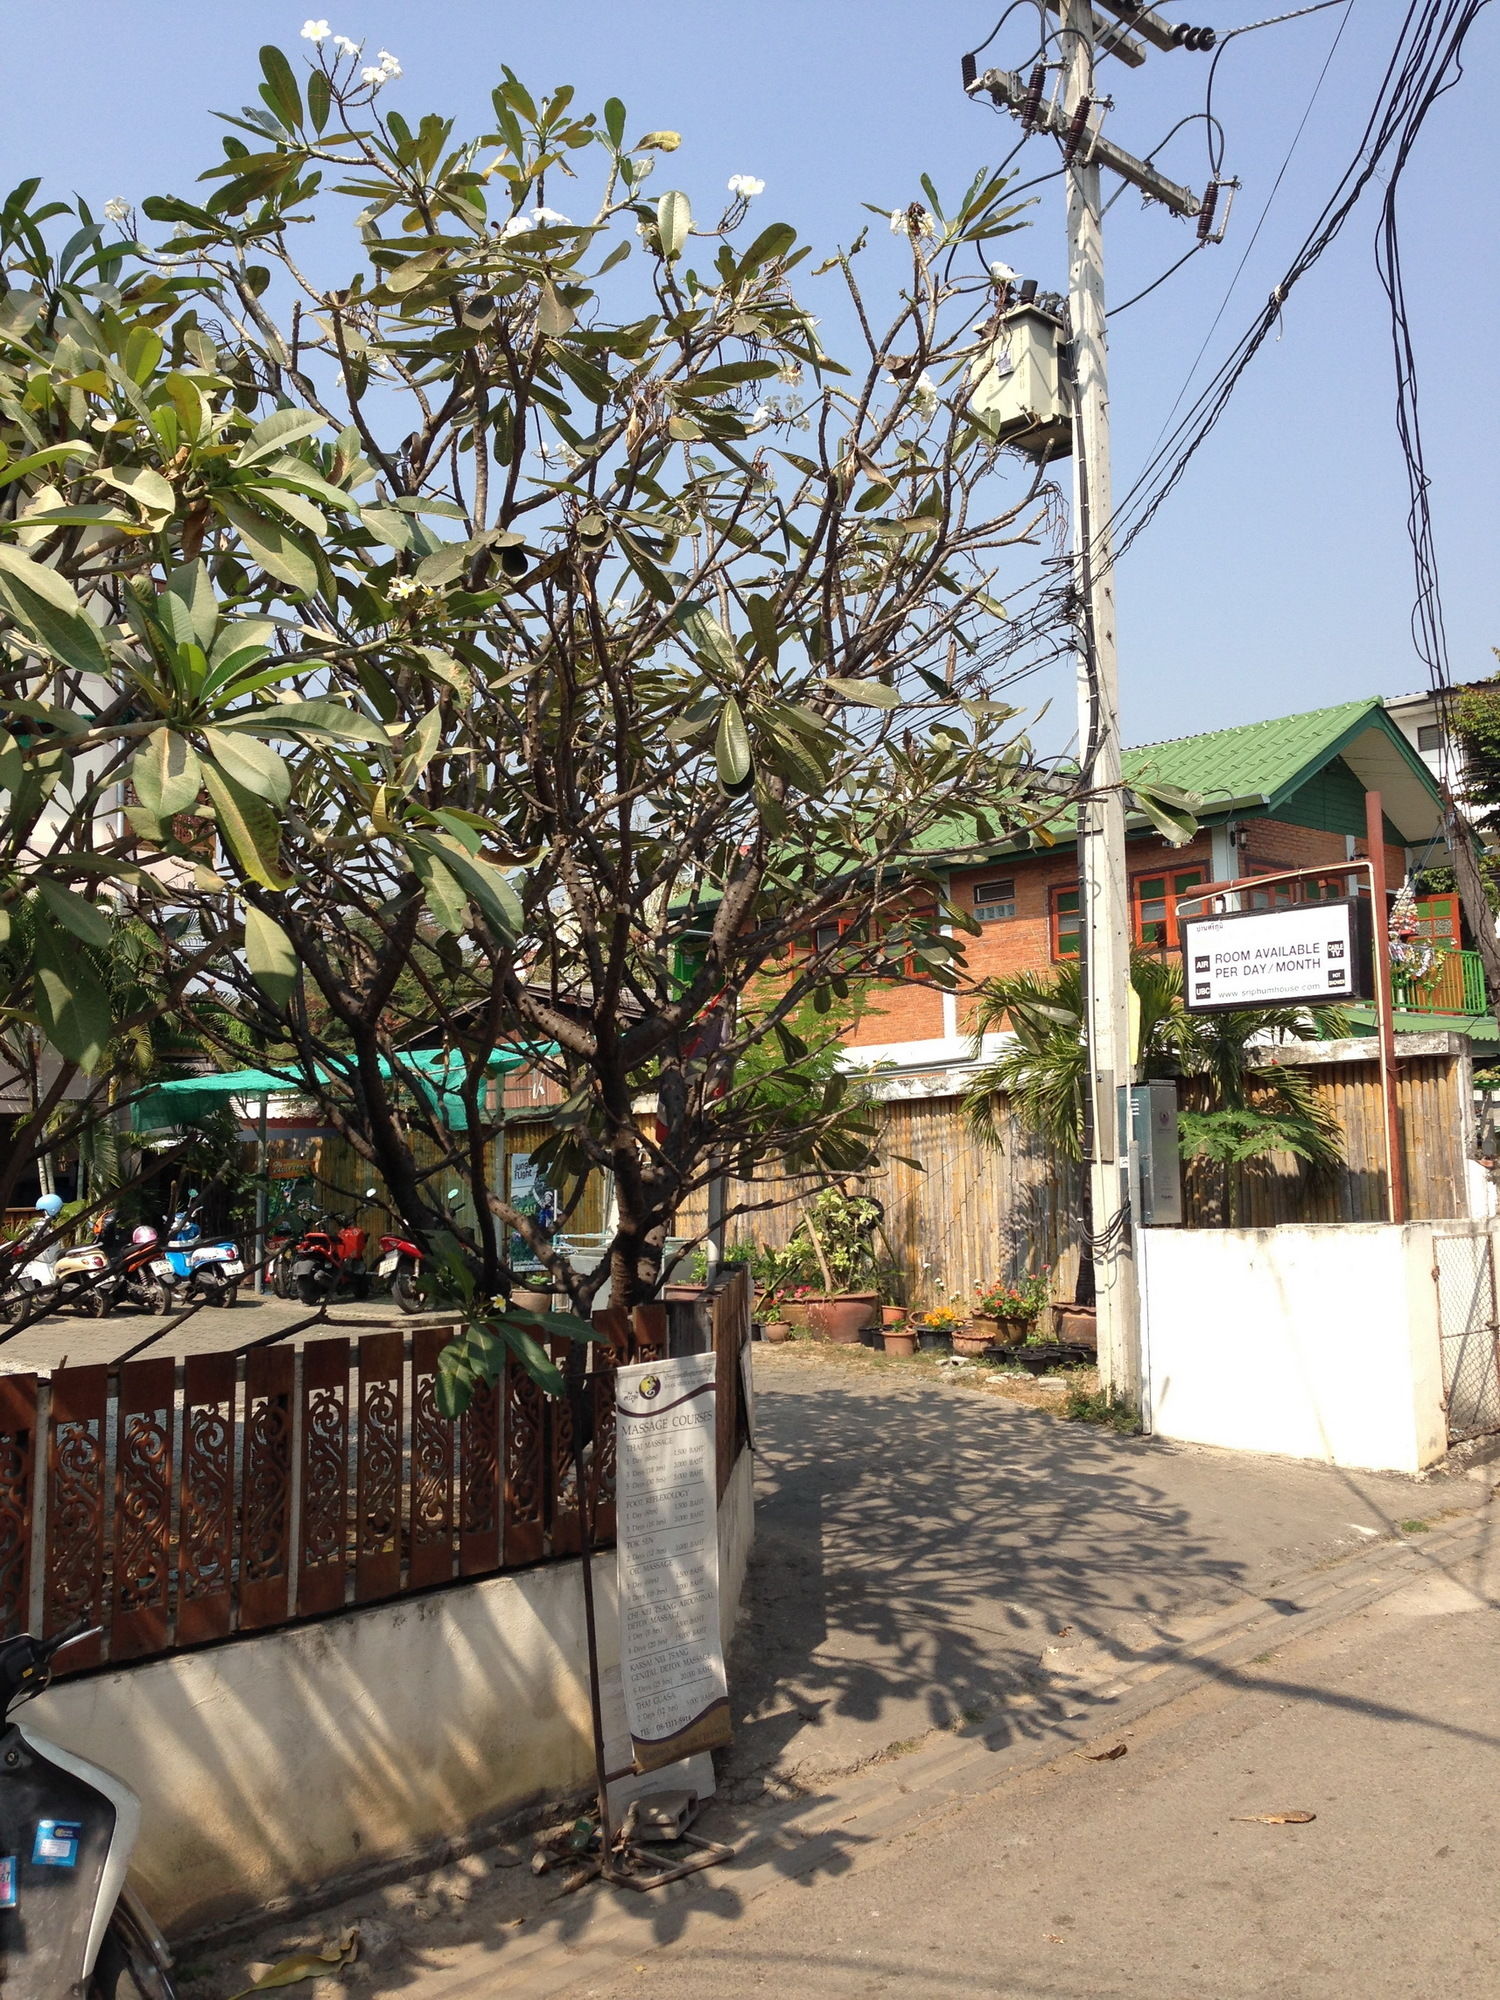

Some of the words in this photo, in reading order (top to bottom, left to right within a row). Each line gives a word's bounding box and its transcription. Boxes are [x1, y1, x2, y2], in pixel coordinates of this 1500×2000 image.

[1215, 950, 1250, 964] ROOM
[1255, 942, 1320, 958] AVAILABLE
[1196, 961, 1209, 969] AIR
[1216, 966, 1238, 978] PER
[1196, 987, 1211, 995] UBC
[622, 1418, 668, 1436] MASSAGE
[672, 1411, 713, 1427] COURSES
[644, 1438, 673, 1449] MASSAGE
